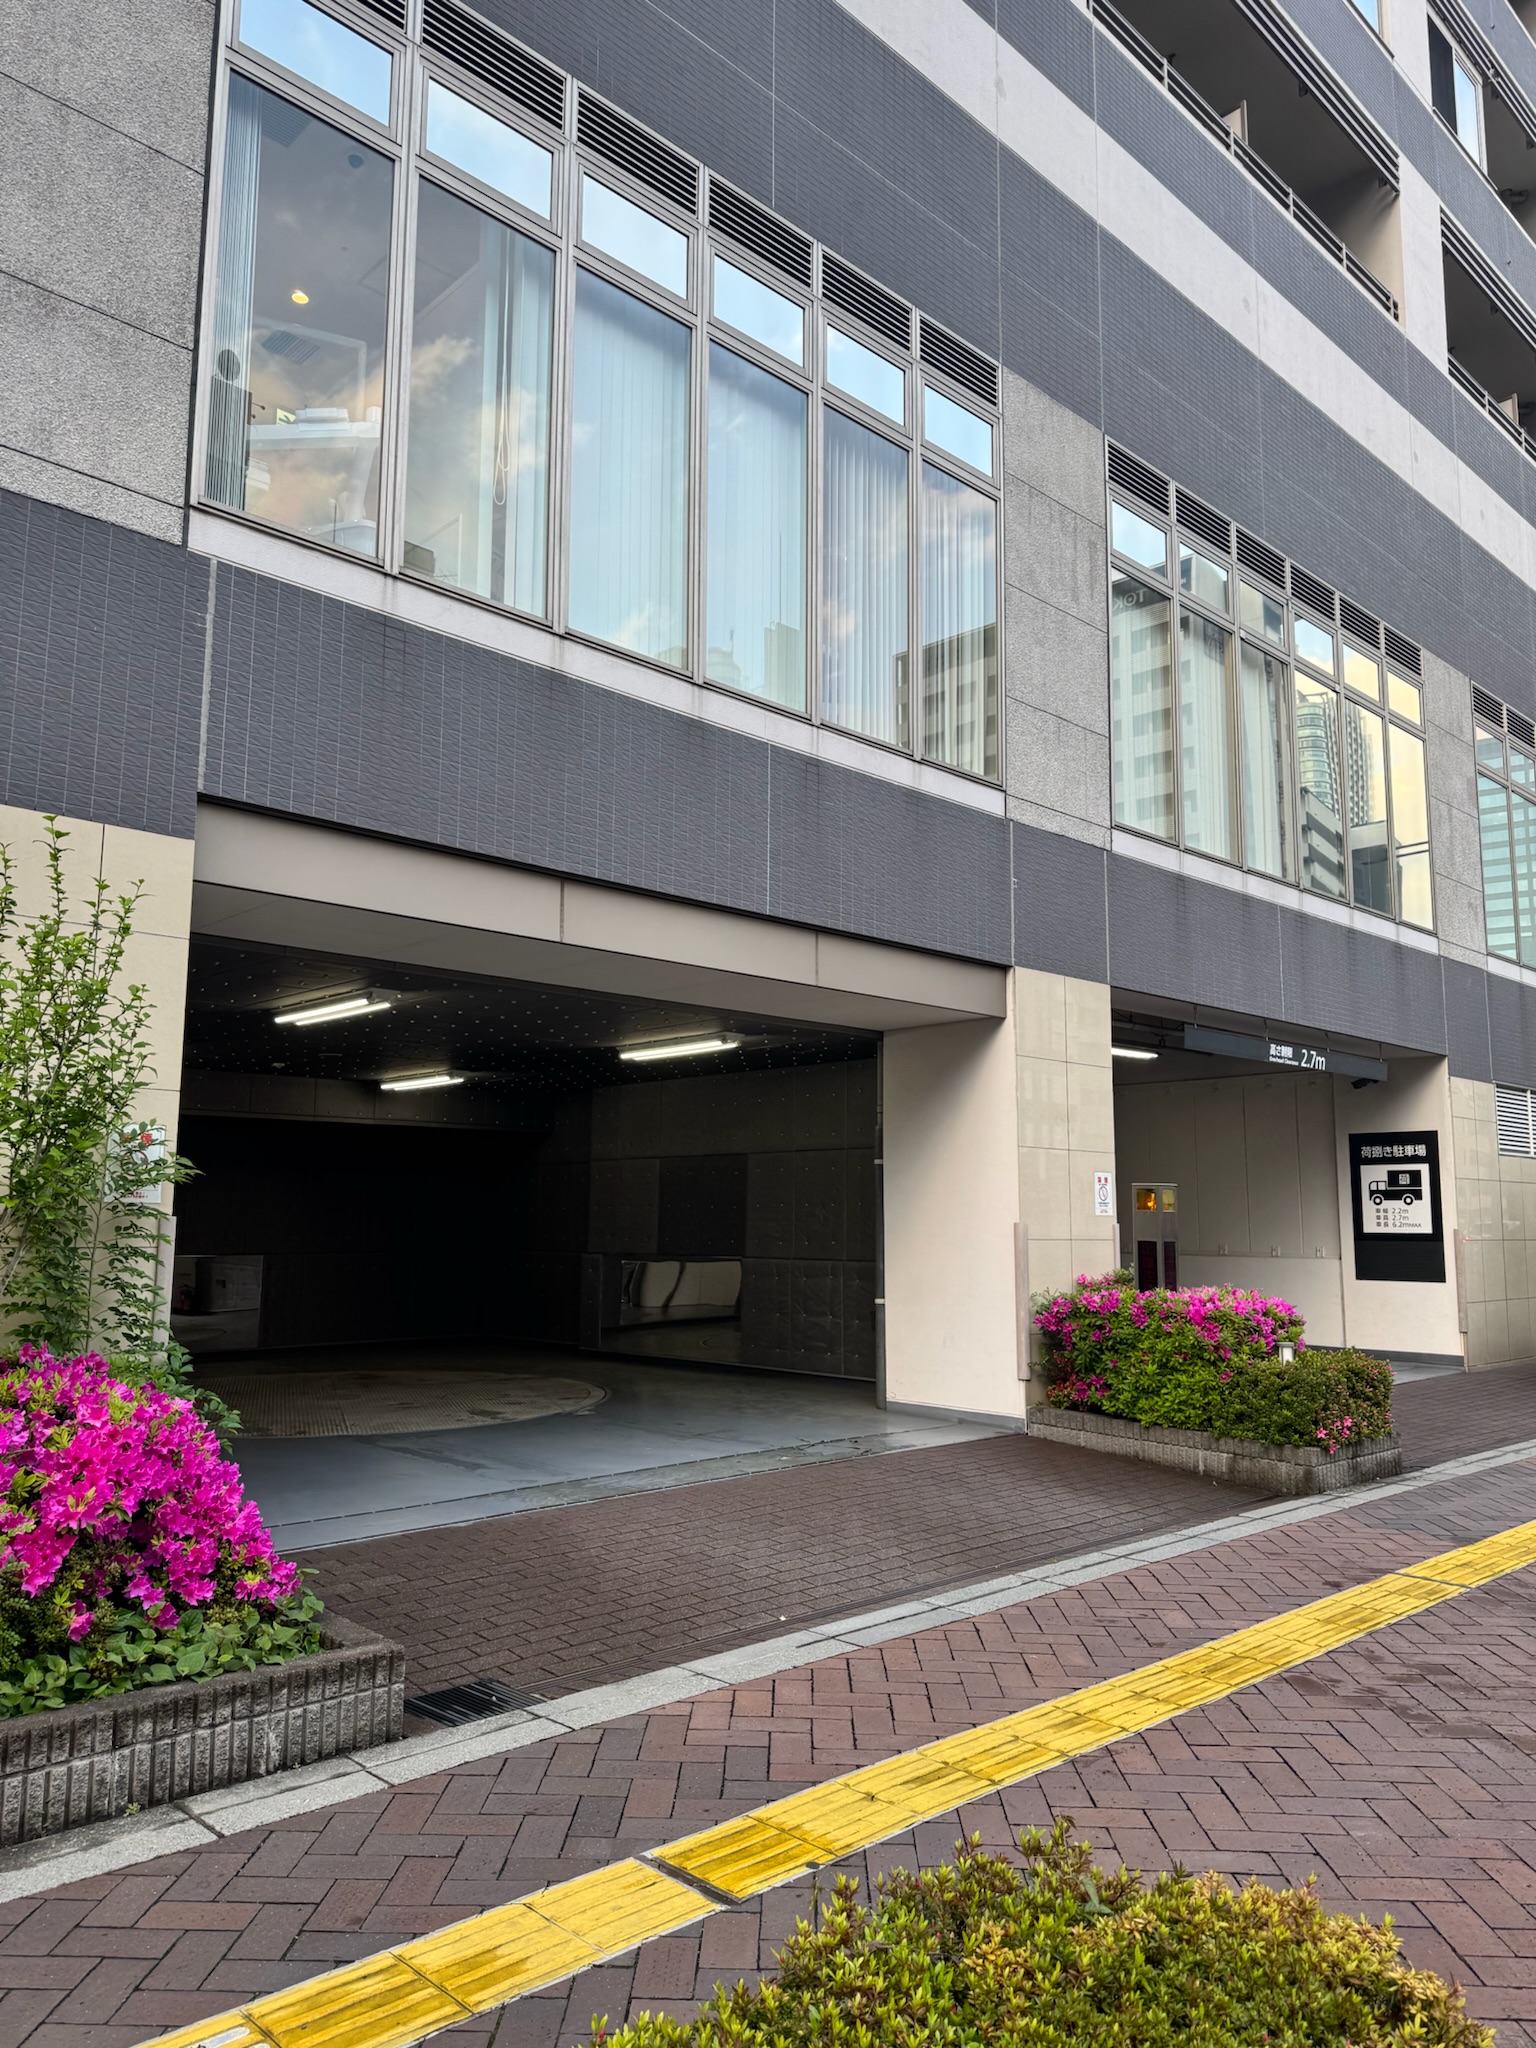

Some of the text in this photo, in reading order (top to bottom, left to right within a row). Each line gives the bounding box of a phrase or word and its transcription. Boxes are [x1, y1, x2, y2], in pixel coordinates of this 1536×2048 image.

[1301, 1049, 1326, 1070] 2.7m
[1360, 1144, 1427, 1158] 荷捌き駐車場
